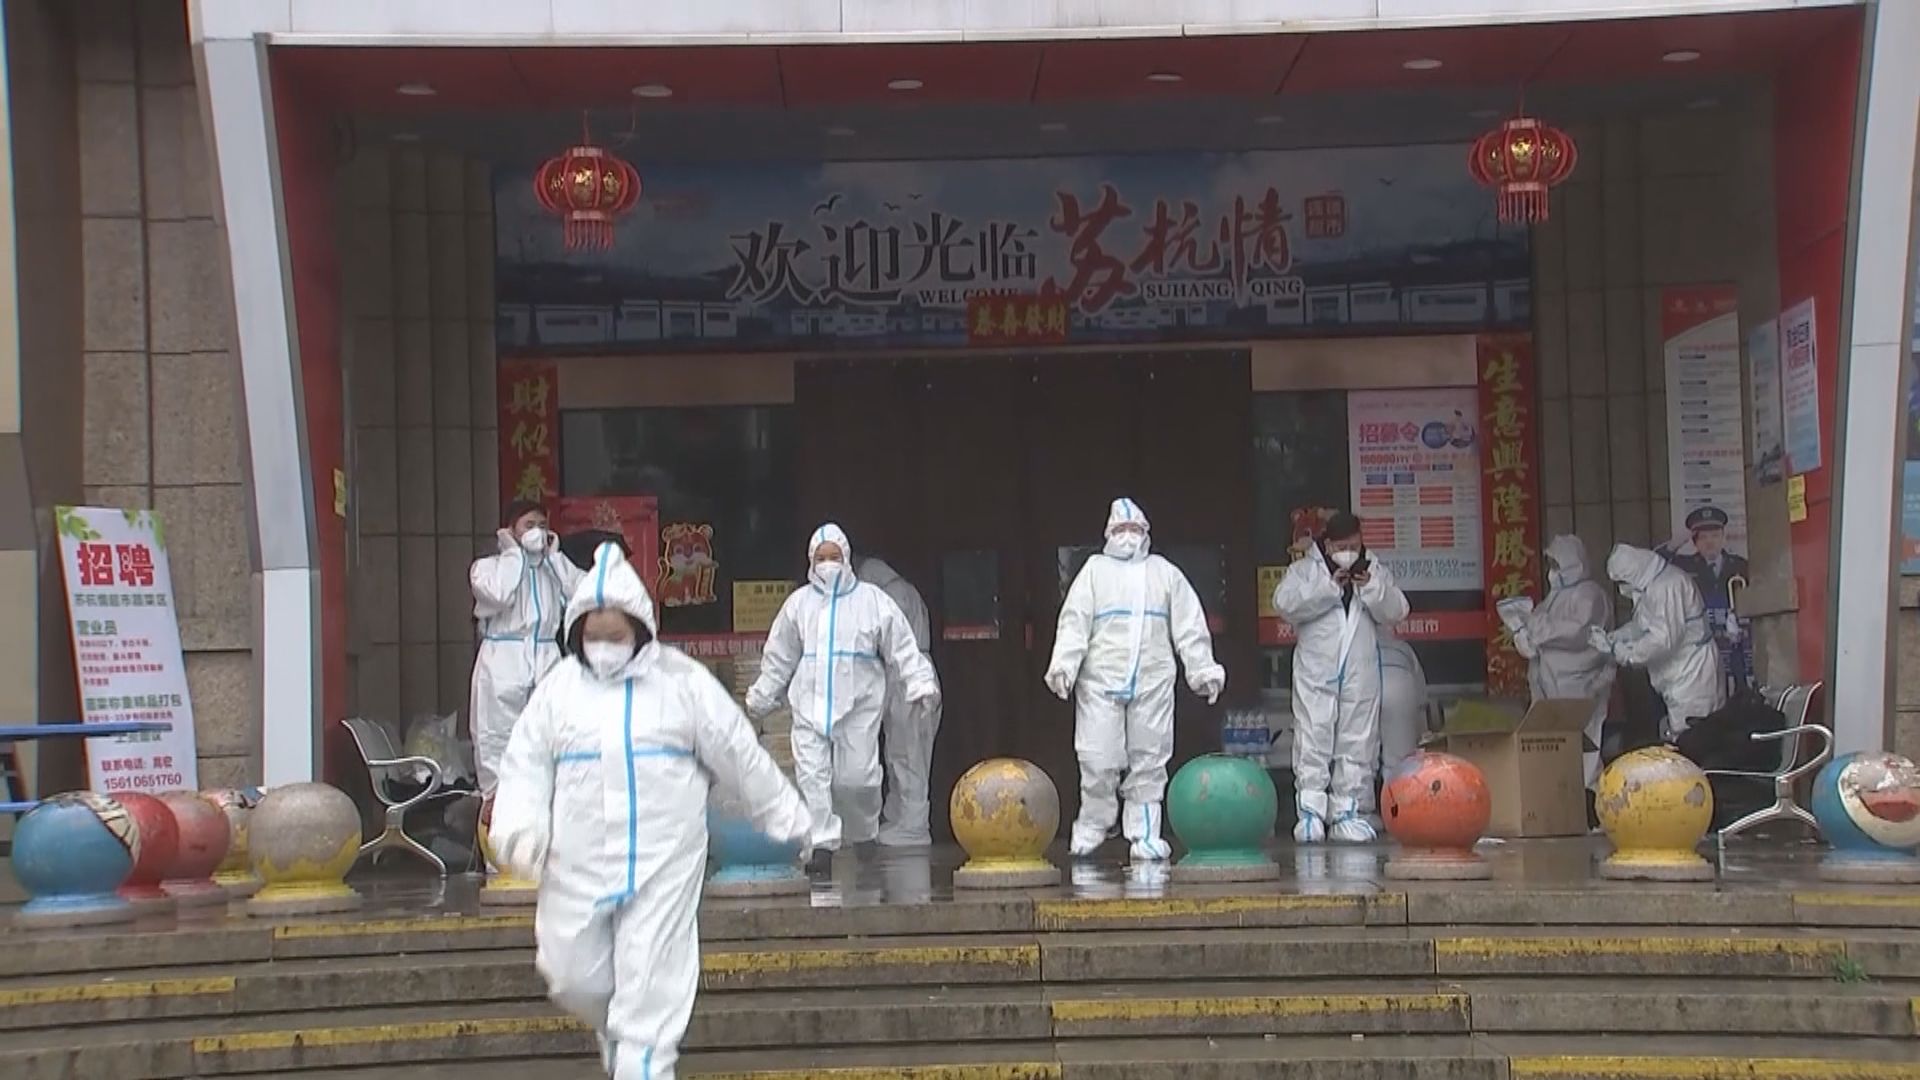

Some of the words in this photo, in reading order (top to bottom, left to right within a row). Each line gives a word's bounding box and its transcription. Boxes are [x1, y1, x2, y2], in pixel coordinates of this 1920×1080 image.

[726, 212, 1038, 303] 欢迎光临
[1043, 185, 1293, 312] 苏杭情
[1145, 281, 1229, 298] SUHANG
[1251, 280, 1302, 297] QING
[76, 542, 155, 587] 招聘
